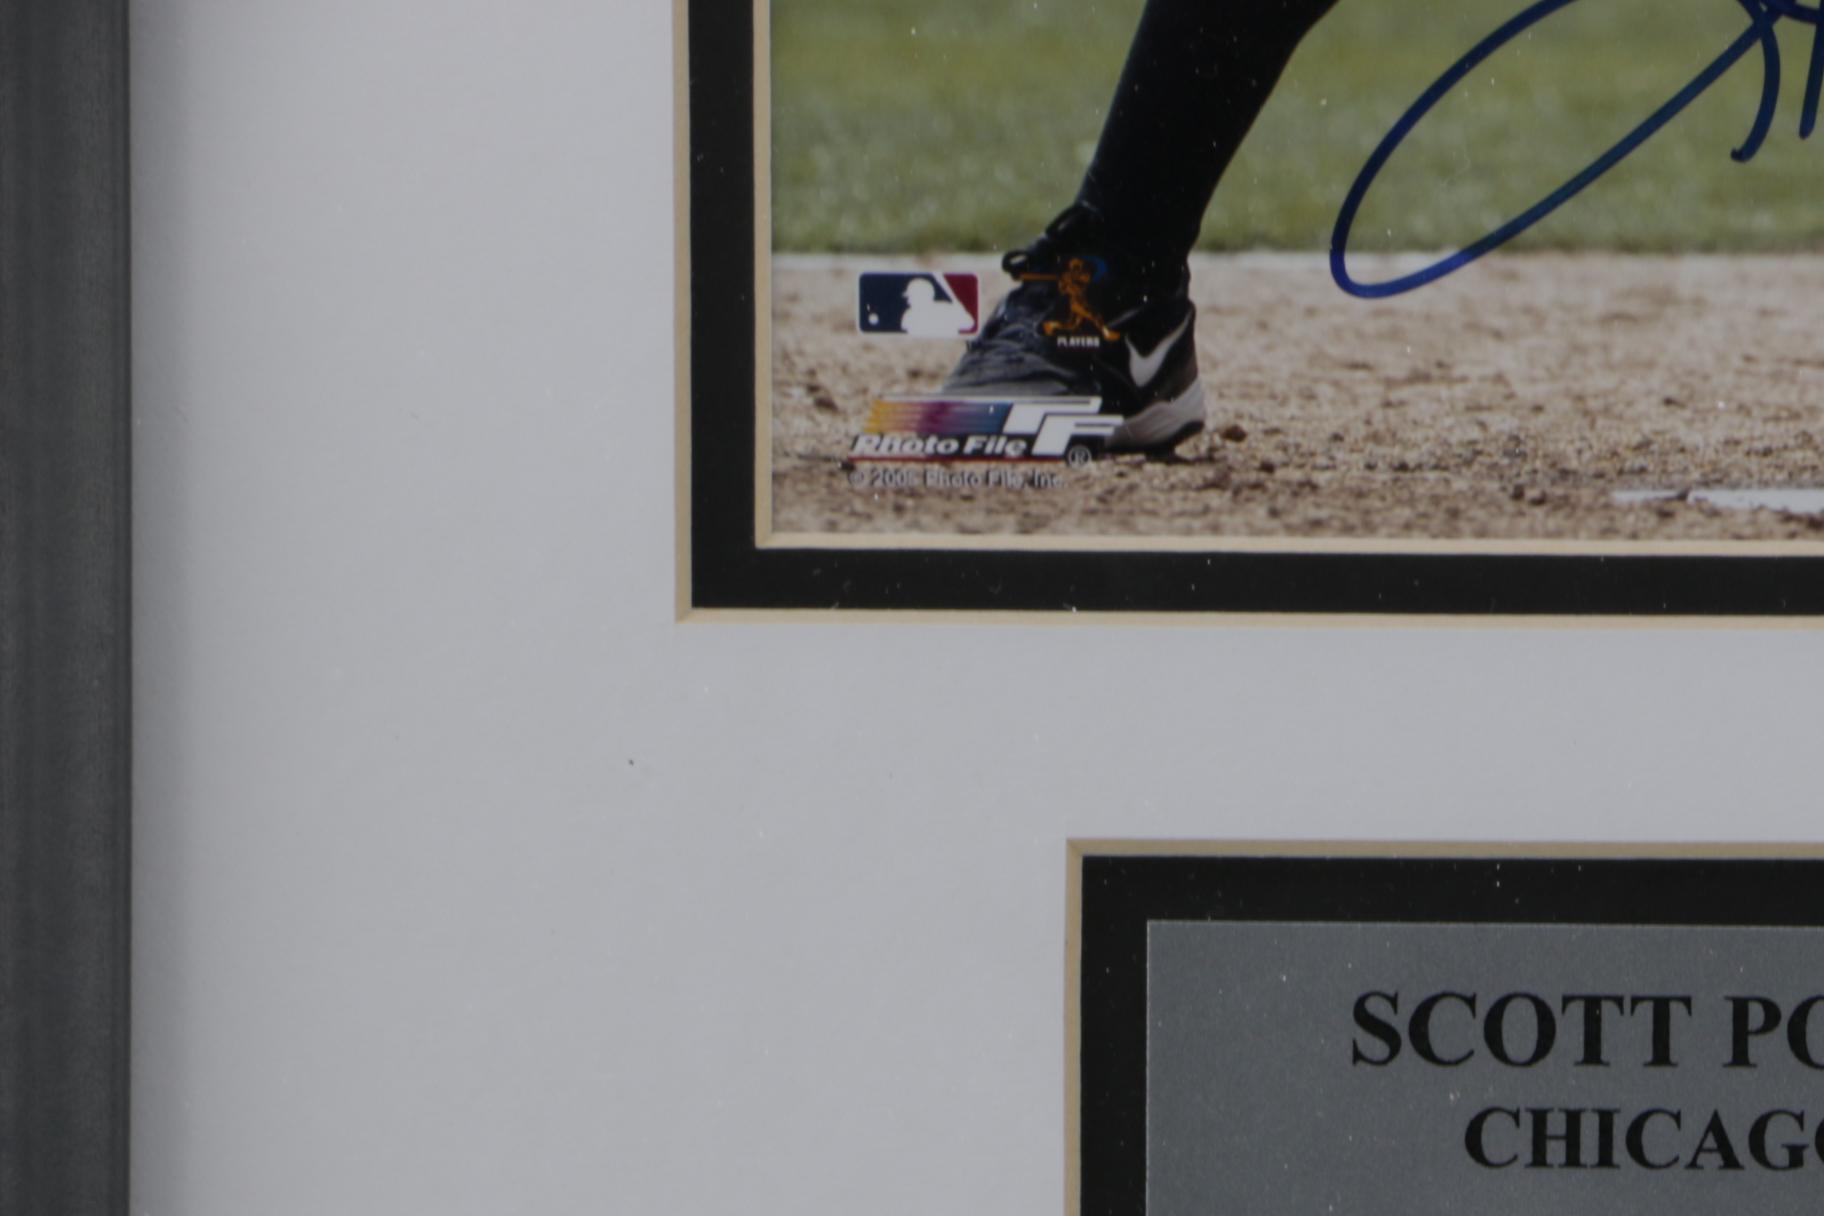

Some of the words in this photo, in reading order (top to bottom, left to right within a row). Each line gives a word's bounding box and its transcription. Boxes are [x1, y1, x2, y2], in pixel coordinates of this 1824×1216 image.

[853, 437, 958, 456] Photo
[963, 437, 1028, 457] File
[925, 466, 983, 487] Photo
[1351, 989, 1693, 1070] SCOTT
